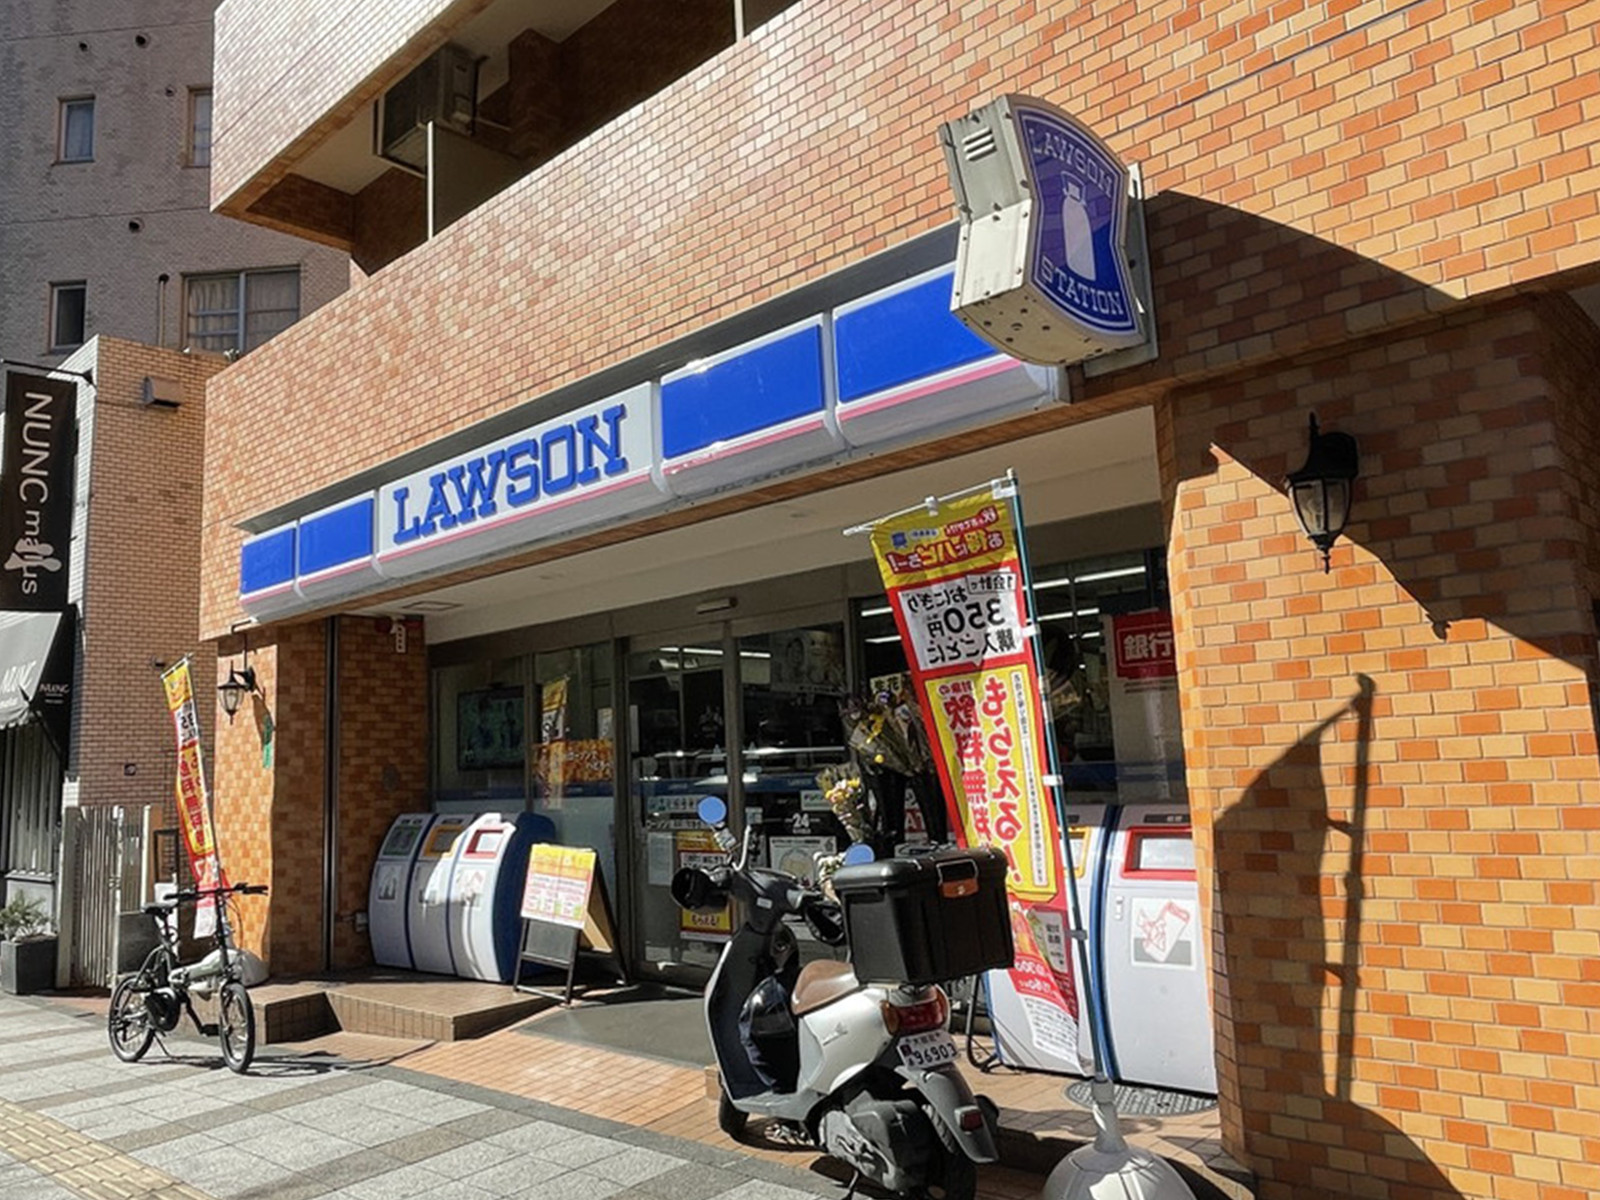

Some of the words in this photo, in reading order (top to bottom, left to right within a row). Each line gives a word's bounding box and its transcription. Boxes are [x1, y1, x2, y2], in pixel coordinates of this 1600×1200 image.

[1029, 128, 1113, 198] LAWSON
[1042, 256, 1124, 316] STATION
[19, 393, 53, 504] NUNC
[392, 403, 628, 546] LAWSON
[1123, 631, 1174, 661] 銀行
[793, 813, 810, 829] 24
[913, 1043, 958, 1065] 96903
